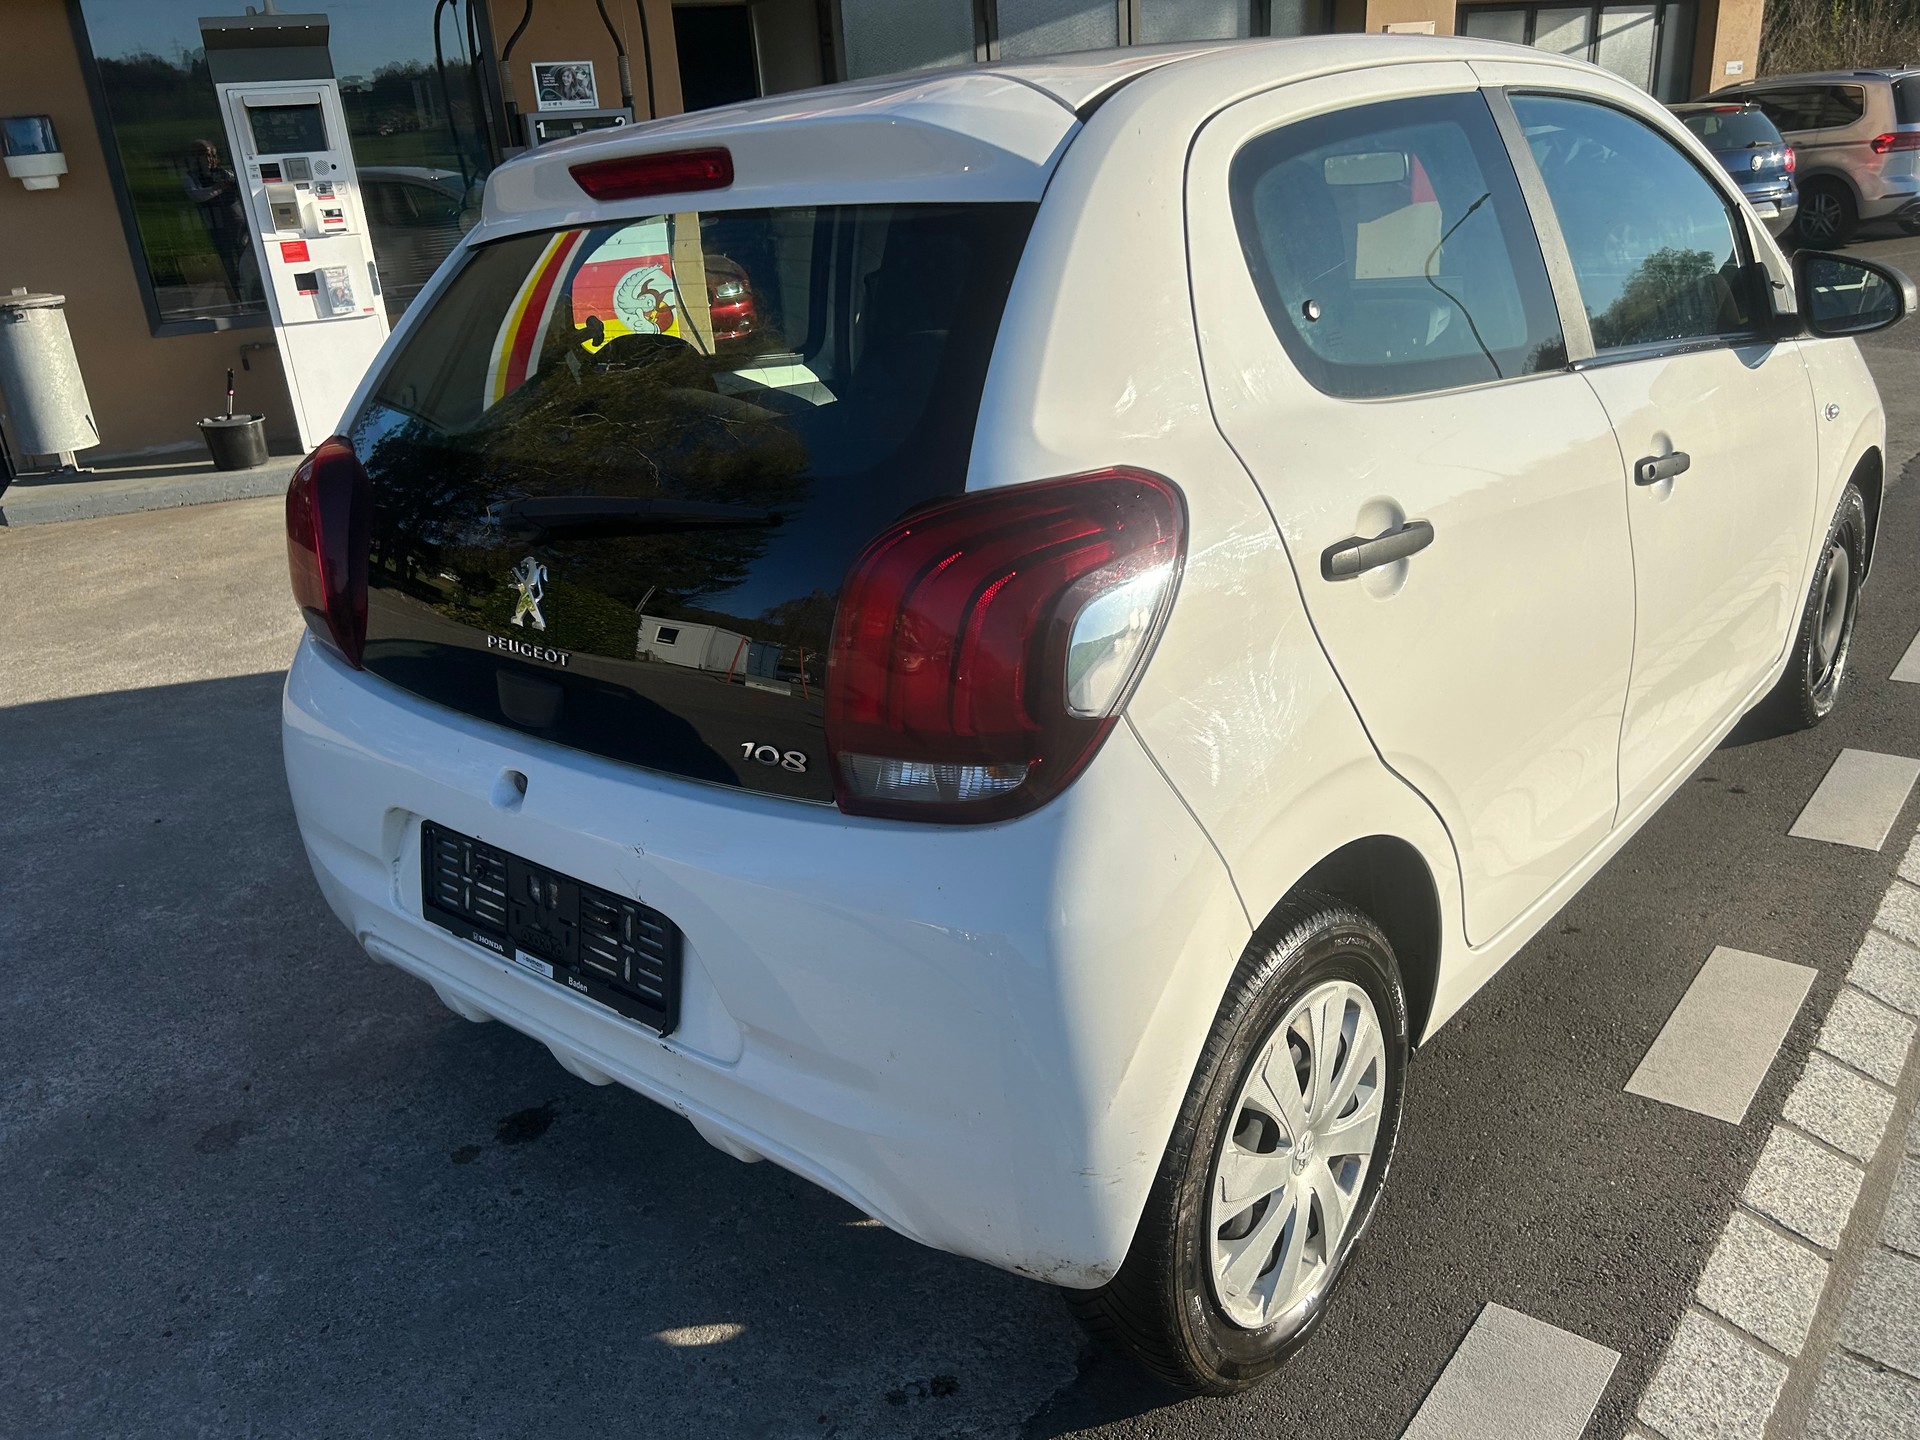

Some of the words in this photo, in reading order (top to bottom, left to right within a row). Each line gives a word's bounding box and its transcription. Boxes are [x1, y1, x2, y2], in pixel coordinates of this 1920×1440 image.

[536, 121, 546, 138] 1
[487, 634, 569, 666] PEUGEOT
[741, 742, 807, 773] 108
[478, 935, 504, 952] HONDA
[568, 976, 588, 993] Baden
